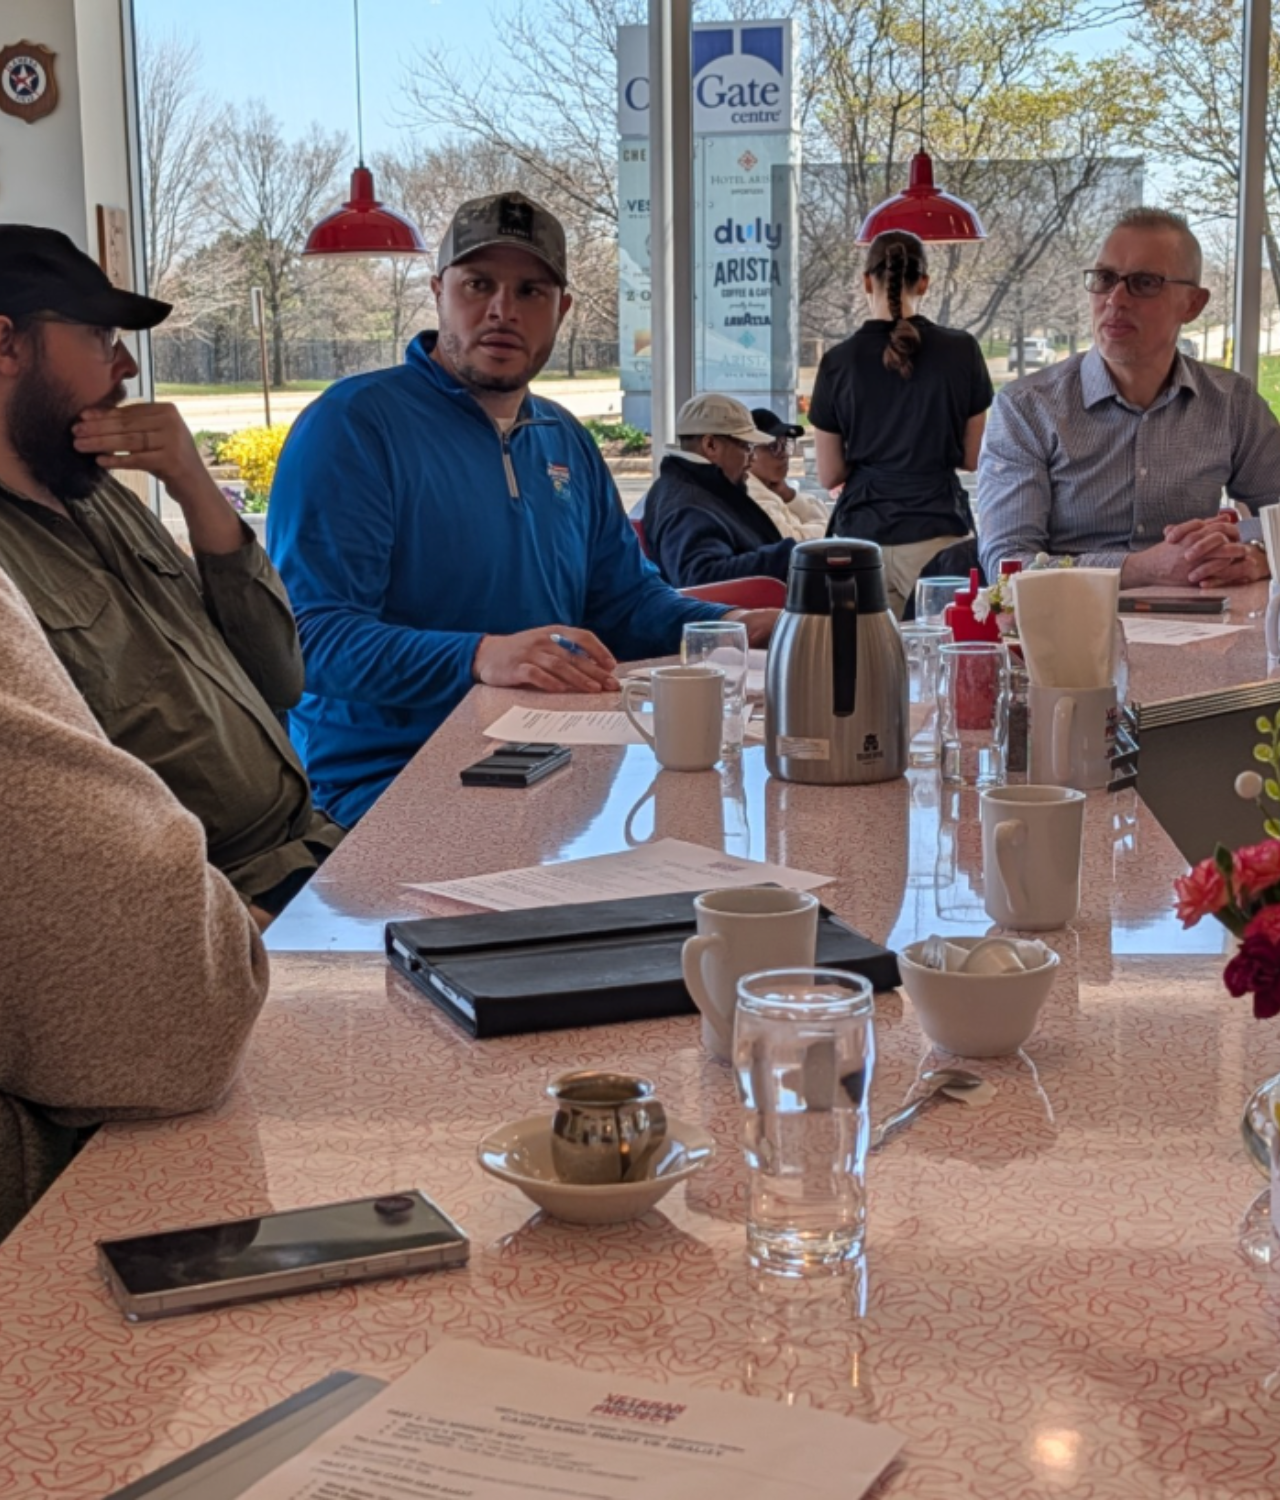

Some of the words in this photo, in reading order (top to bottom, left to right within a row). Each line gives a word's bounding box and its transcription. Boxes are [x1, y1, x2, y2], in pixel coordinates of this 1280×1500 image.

[696, 74, 780, 109] Gate
[731, 110, 780, 124] centre
[711, 175, 745, 185] HOTEL
[714, 217, 782, 250] duly
[713, 257, 782, 288] ARISTA
[721, 287, 747, 298] COFFEE
[748, 287, 755, 298] &
